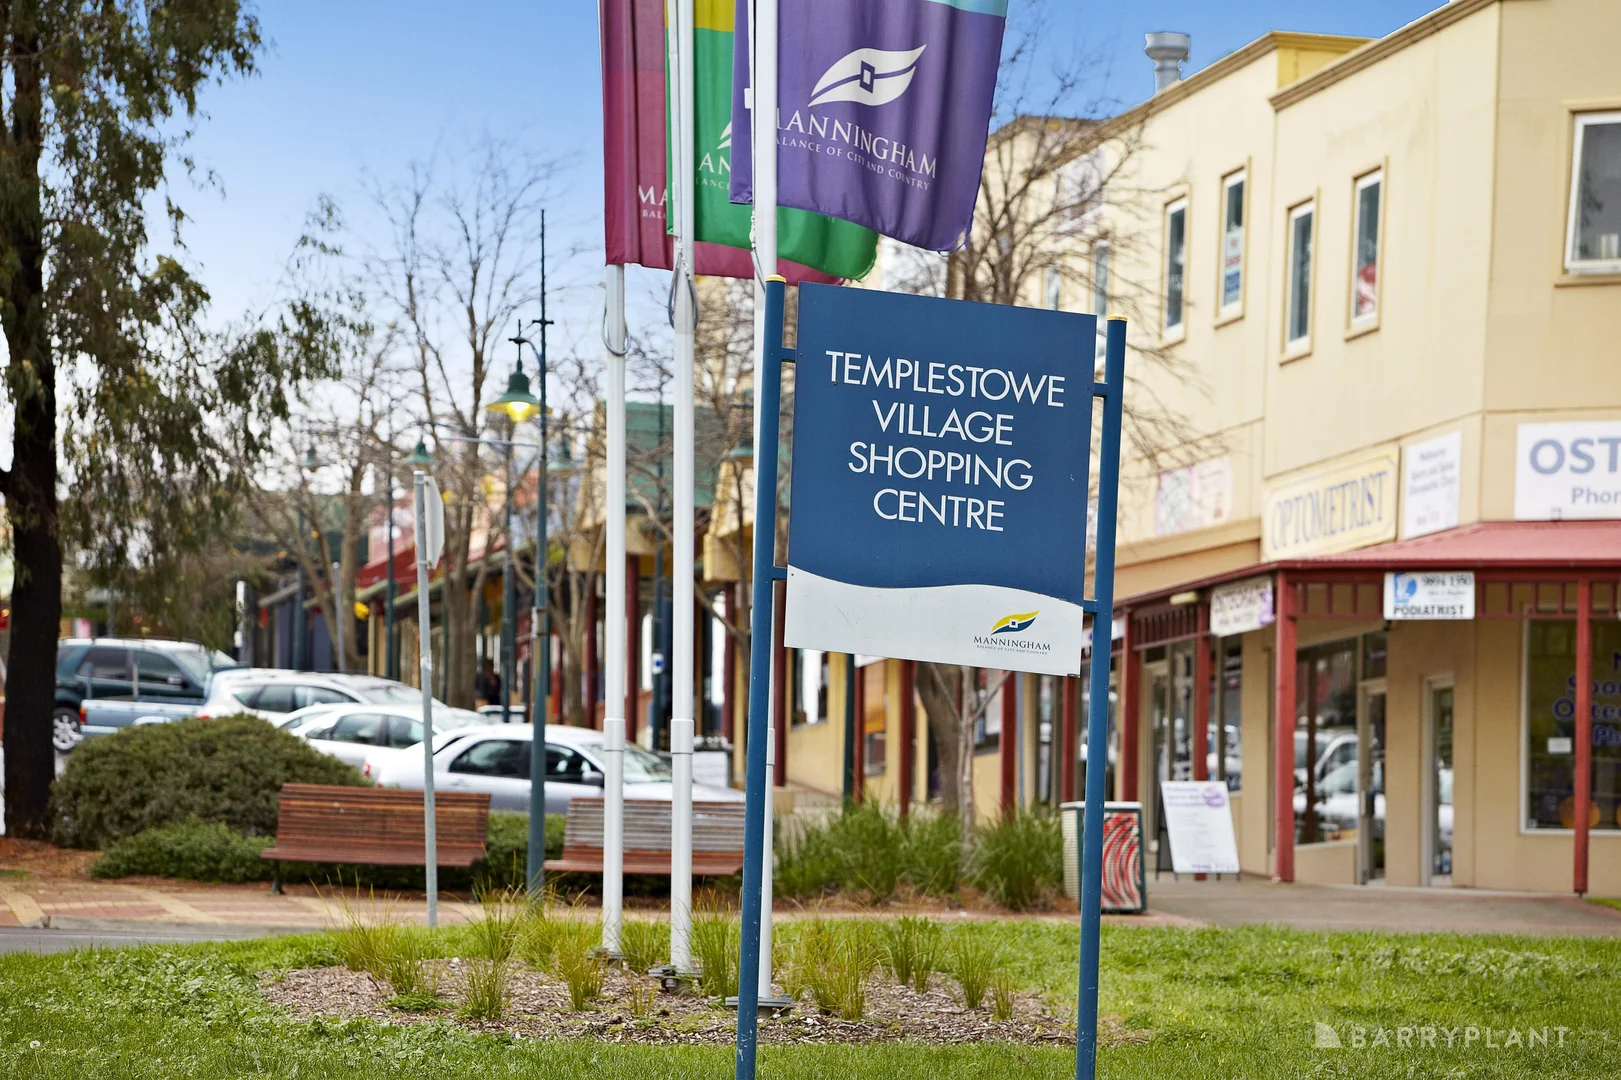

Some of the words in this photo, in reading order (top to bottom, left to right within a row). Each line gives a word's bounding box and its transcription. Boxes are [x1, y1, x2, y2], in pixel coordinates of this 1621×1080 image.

[826, 146, 843, 157] OF
[866, 162, 885, 174] AND
[825, 350, 1066, 408] TEMPLESTOWE
[872, 399, 1014, 446] VILLAGE
[848, 441, 1034, 491] SHOPPING
[873, 488, 1005, 532] CENTRE
[1270, 470, 1388, 551] OPTOMETRIST
[1393, 604, 1464, 615] PODIATRIST
[973, 636, 1051, 651] MANNINGHAM
